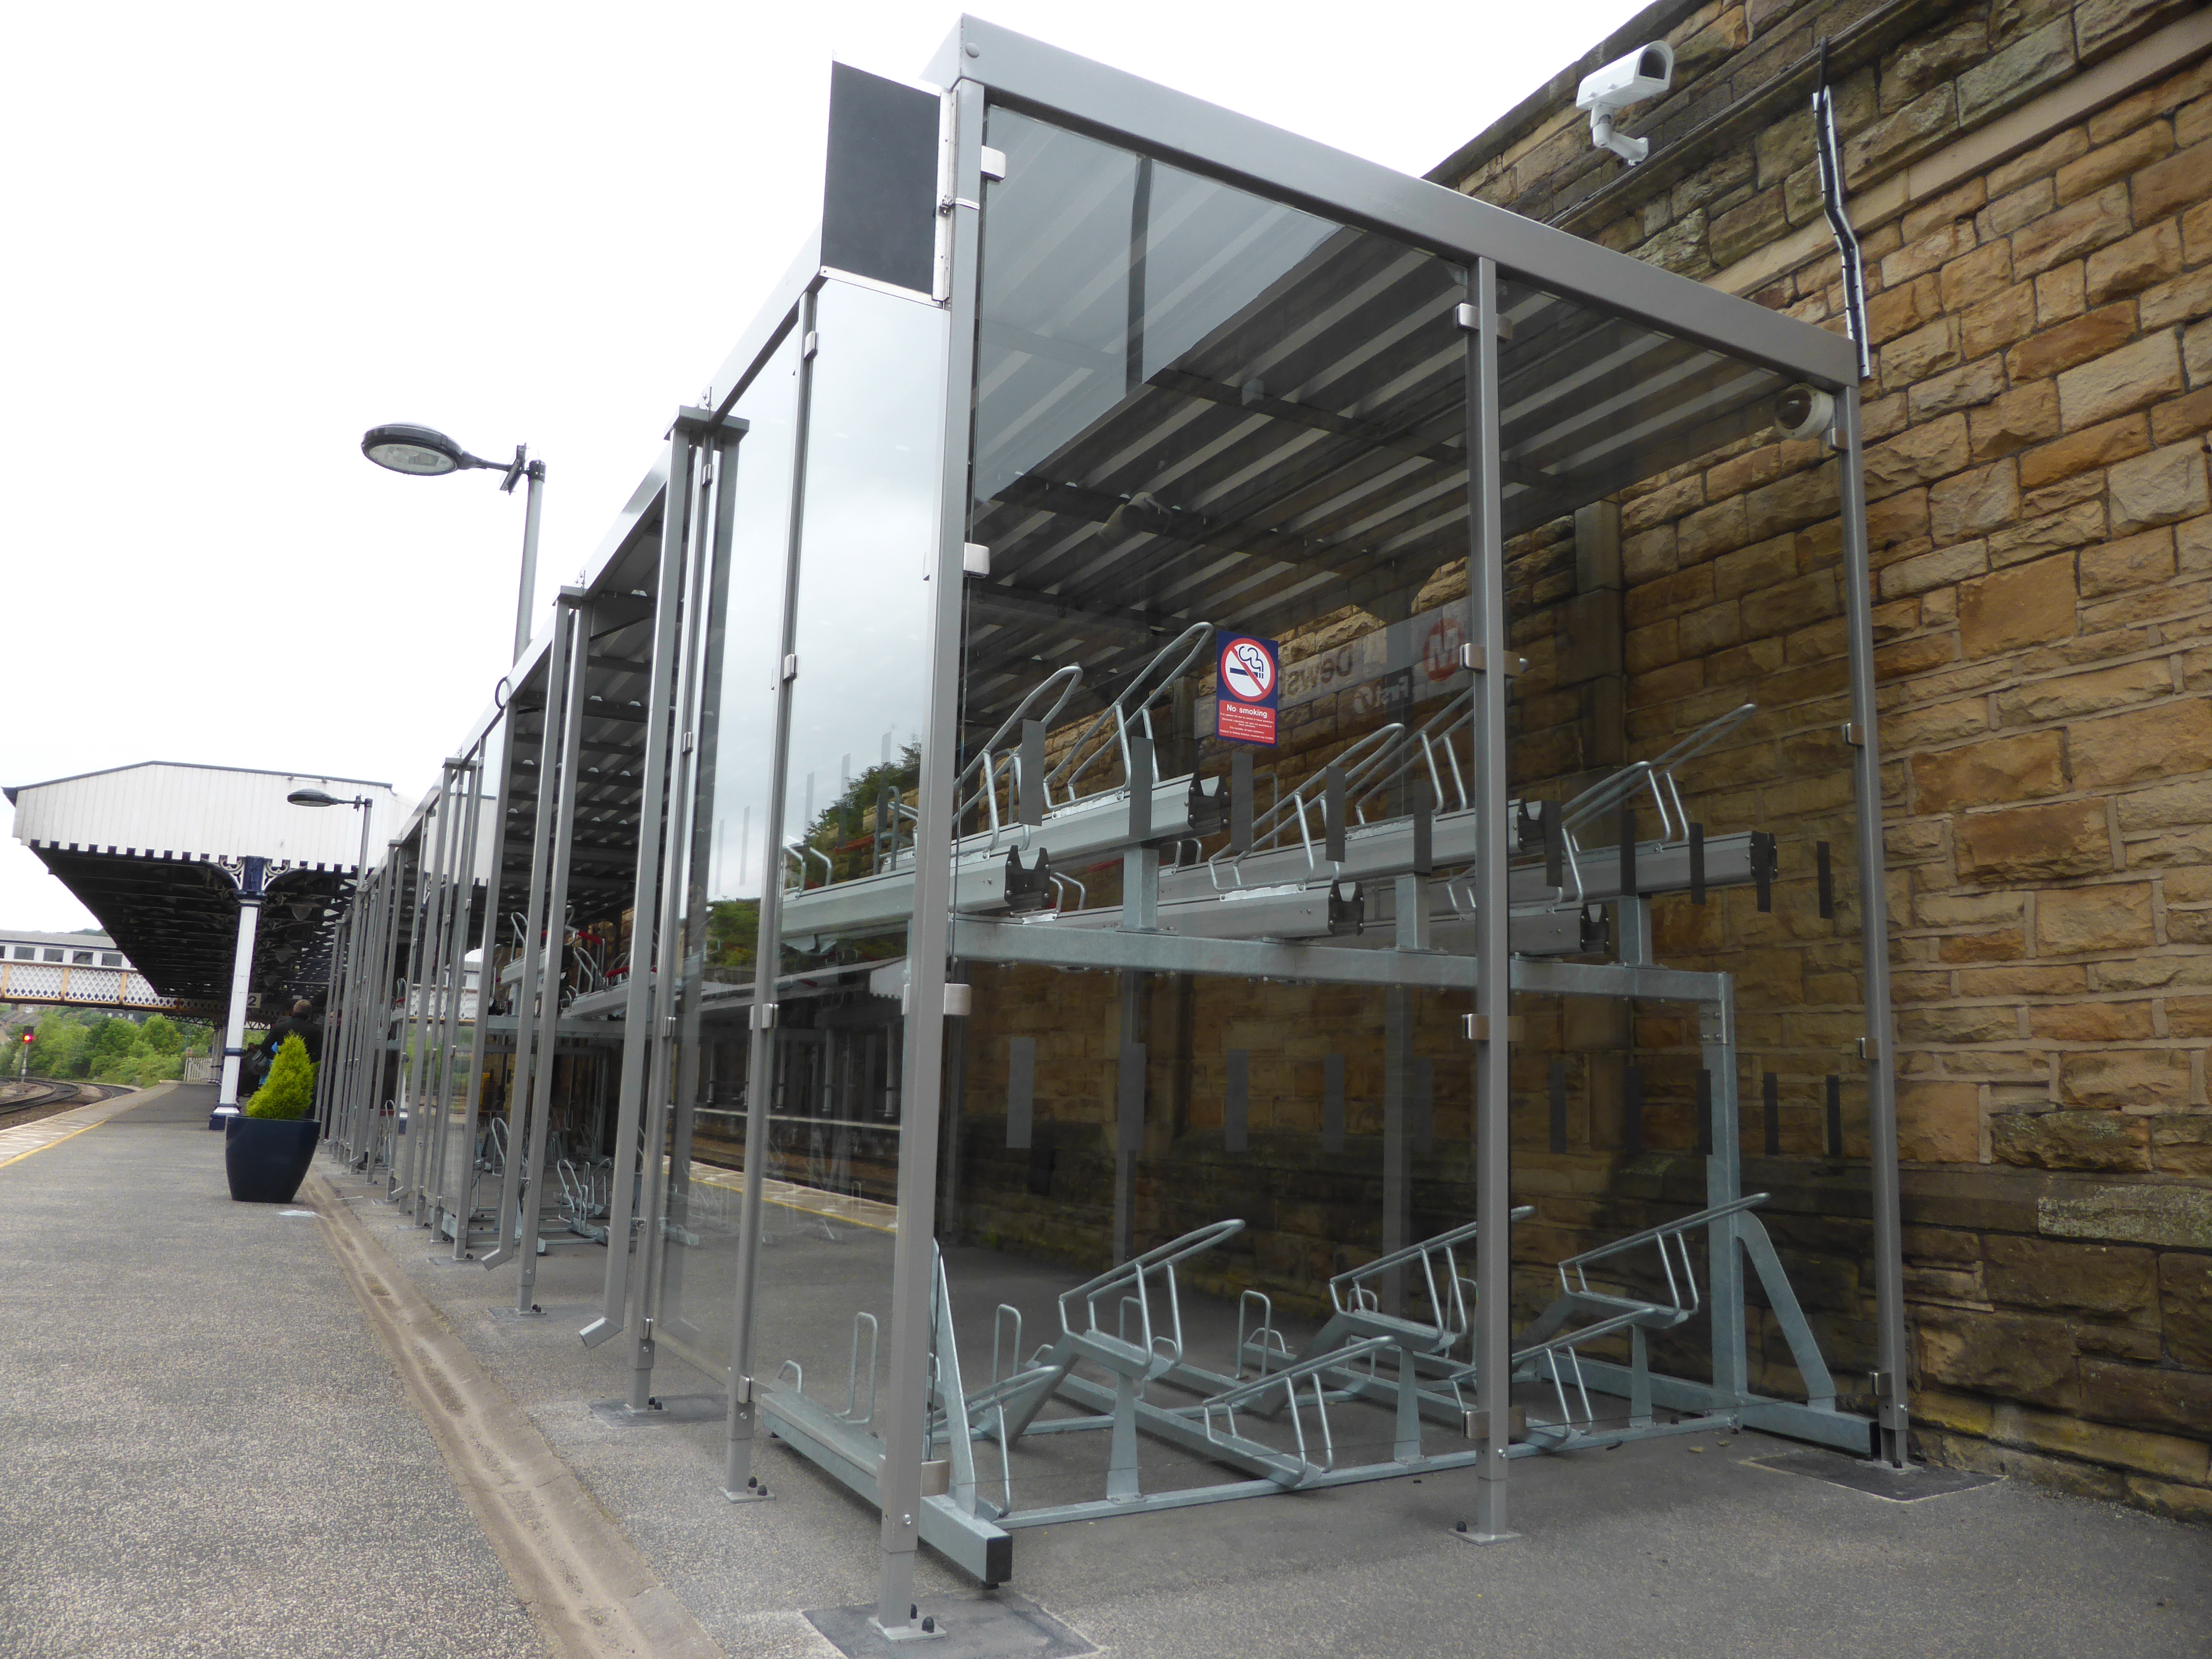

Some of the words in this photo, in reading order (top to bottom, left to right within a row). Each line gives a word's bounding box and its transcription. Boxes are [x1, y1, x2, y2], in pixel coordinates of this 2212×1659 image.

[1227, 704, 1236, 712] No
[1239, 708, 1267, 718] smoking
[248, 996, 257, 1006] 2
